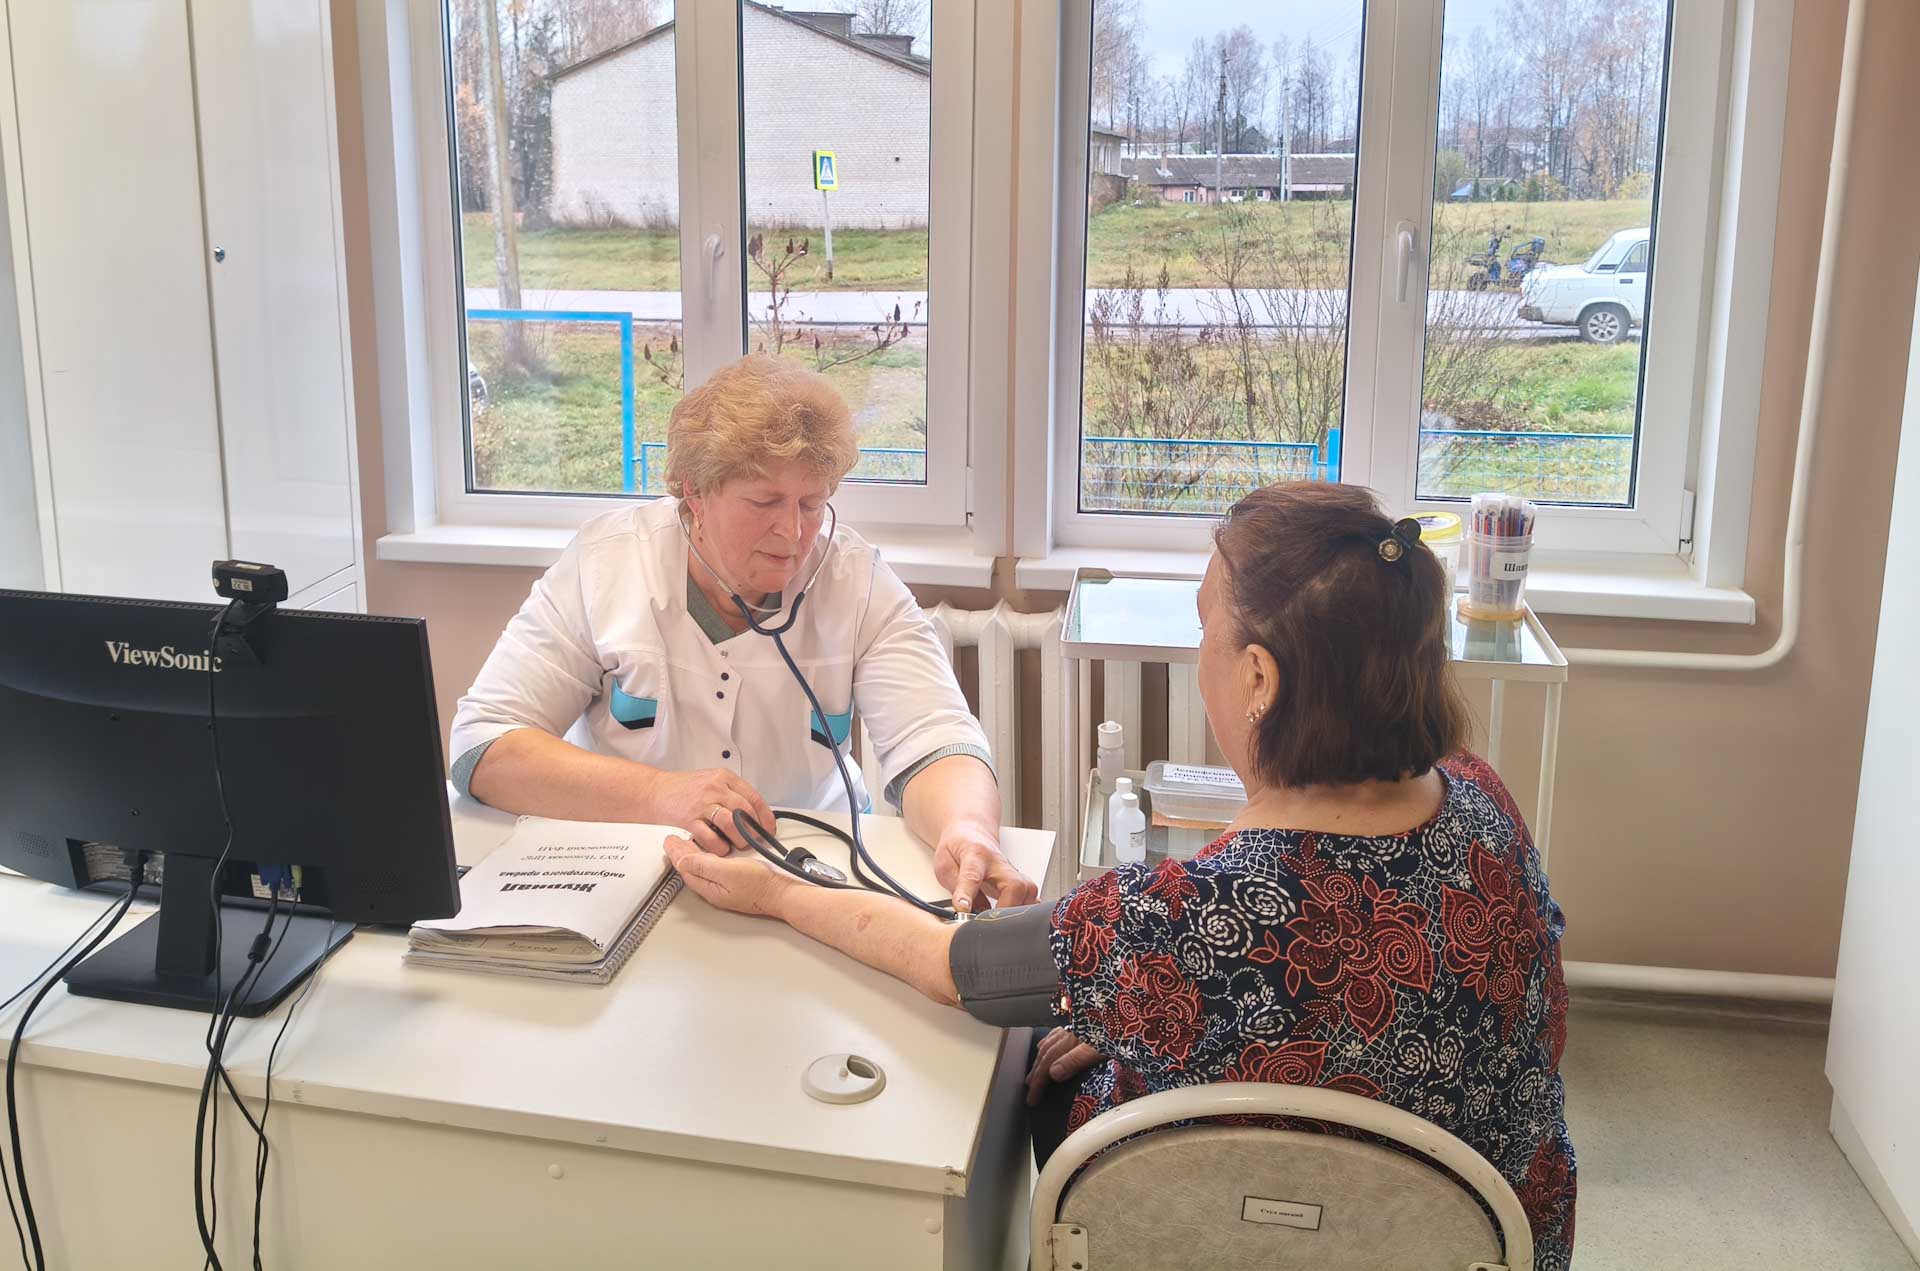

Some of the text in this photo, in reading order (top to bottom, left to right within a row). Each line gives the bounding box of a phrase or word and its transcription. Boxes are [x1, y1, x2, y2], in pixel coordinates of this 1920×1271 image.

[105, 640, 222, 672] ViewSonic
[542, 869, 626, 878] амбулаторного
[500, 883, 597, 892] Журнал
